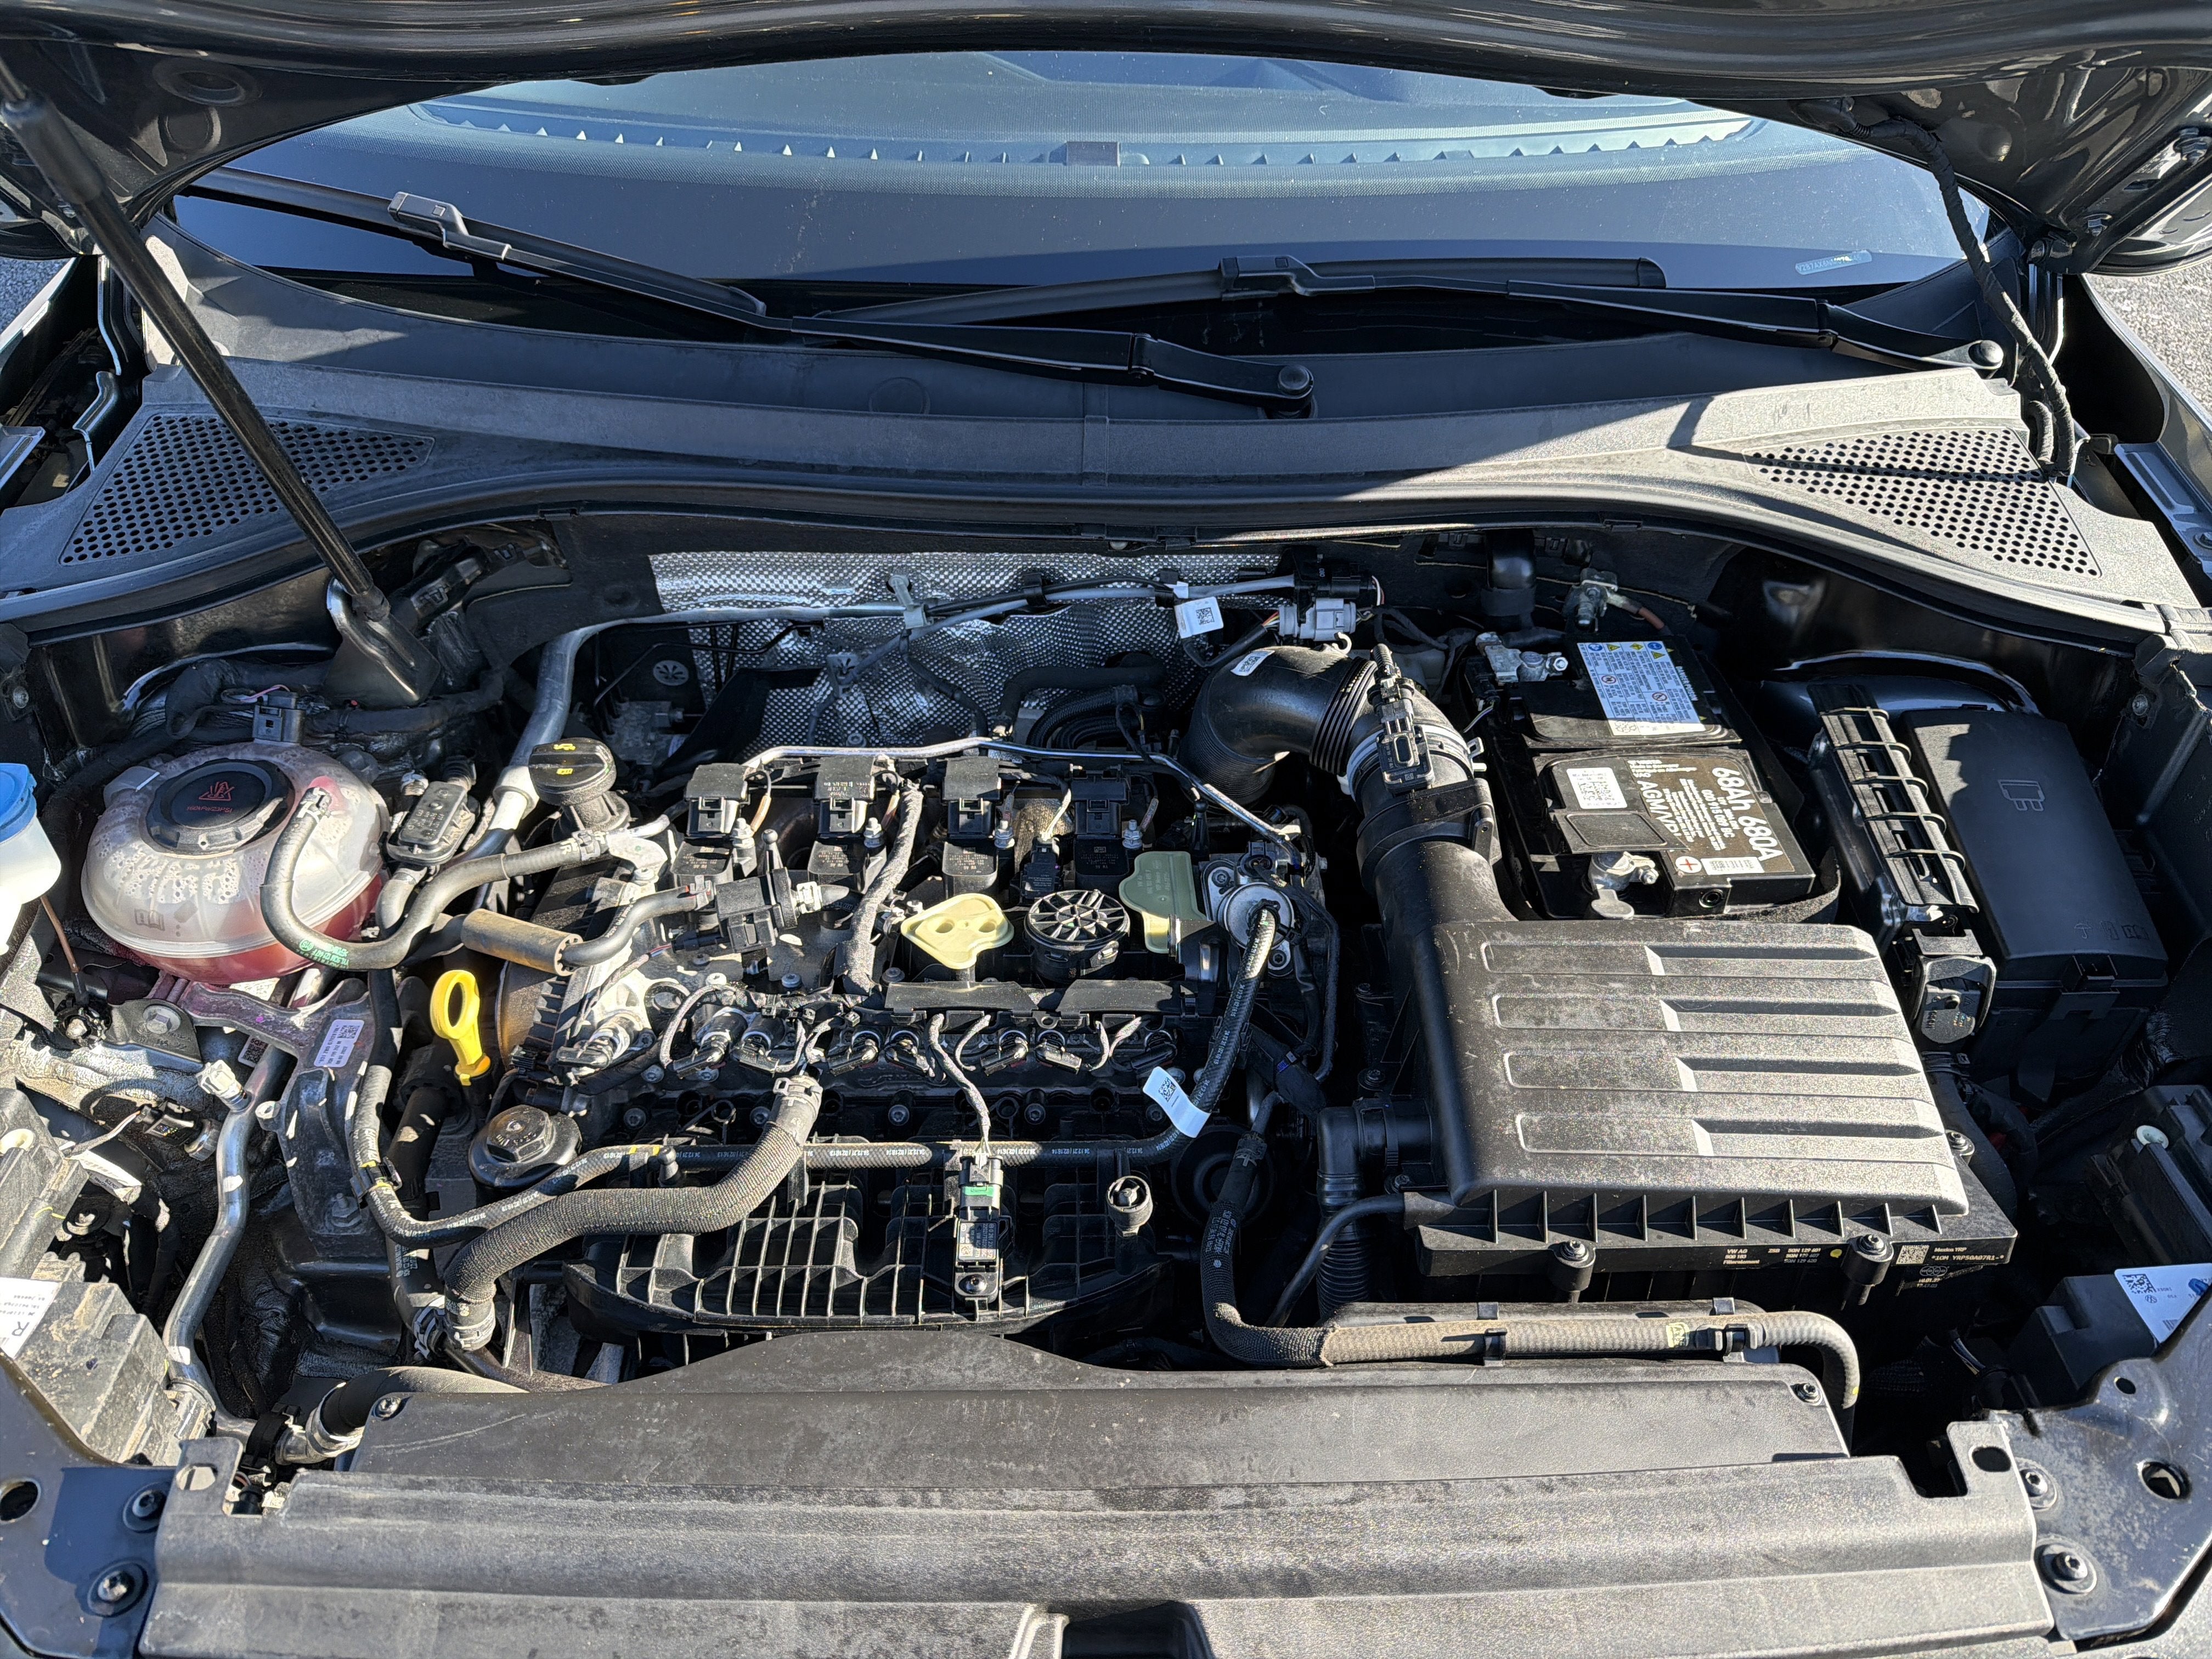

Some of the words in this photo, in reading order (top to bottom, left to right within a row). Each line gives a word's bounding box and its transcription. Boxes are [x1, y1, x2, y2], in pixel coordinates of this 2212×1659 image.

[1674, 665, 1690, 684] DANGER
[1683, 684, 1699, 701] POISON
[1637, 781, 1681, 836] AGM/V
[1707, 802, 1723, 814] 915
[1712, 767, 1756, 810] 68Ah
[1739, 816, 1784, 861] 680A
[11, 1321, 30, 1336] R
